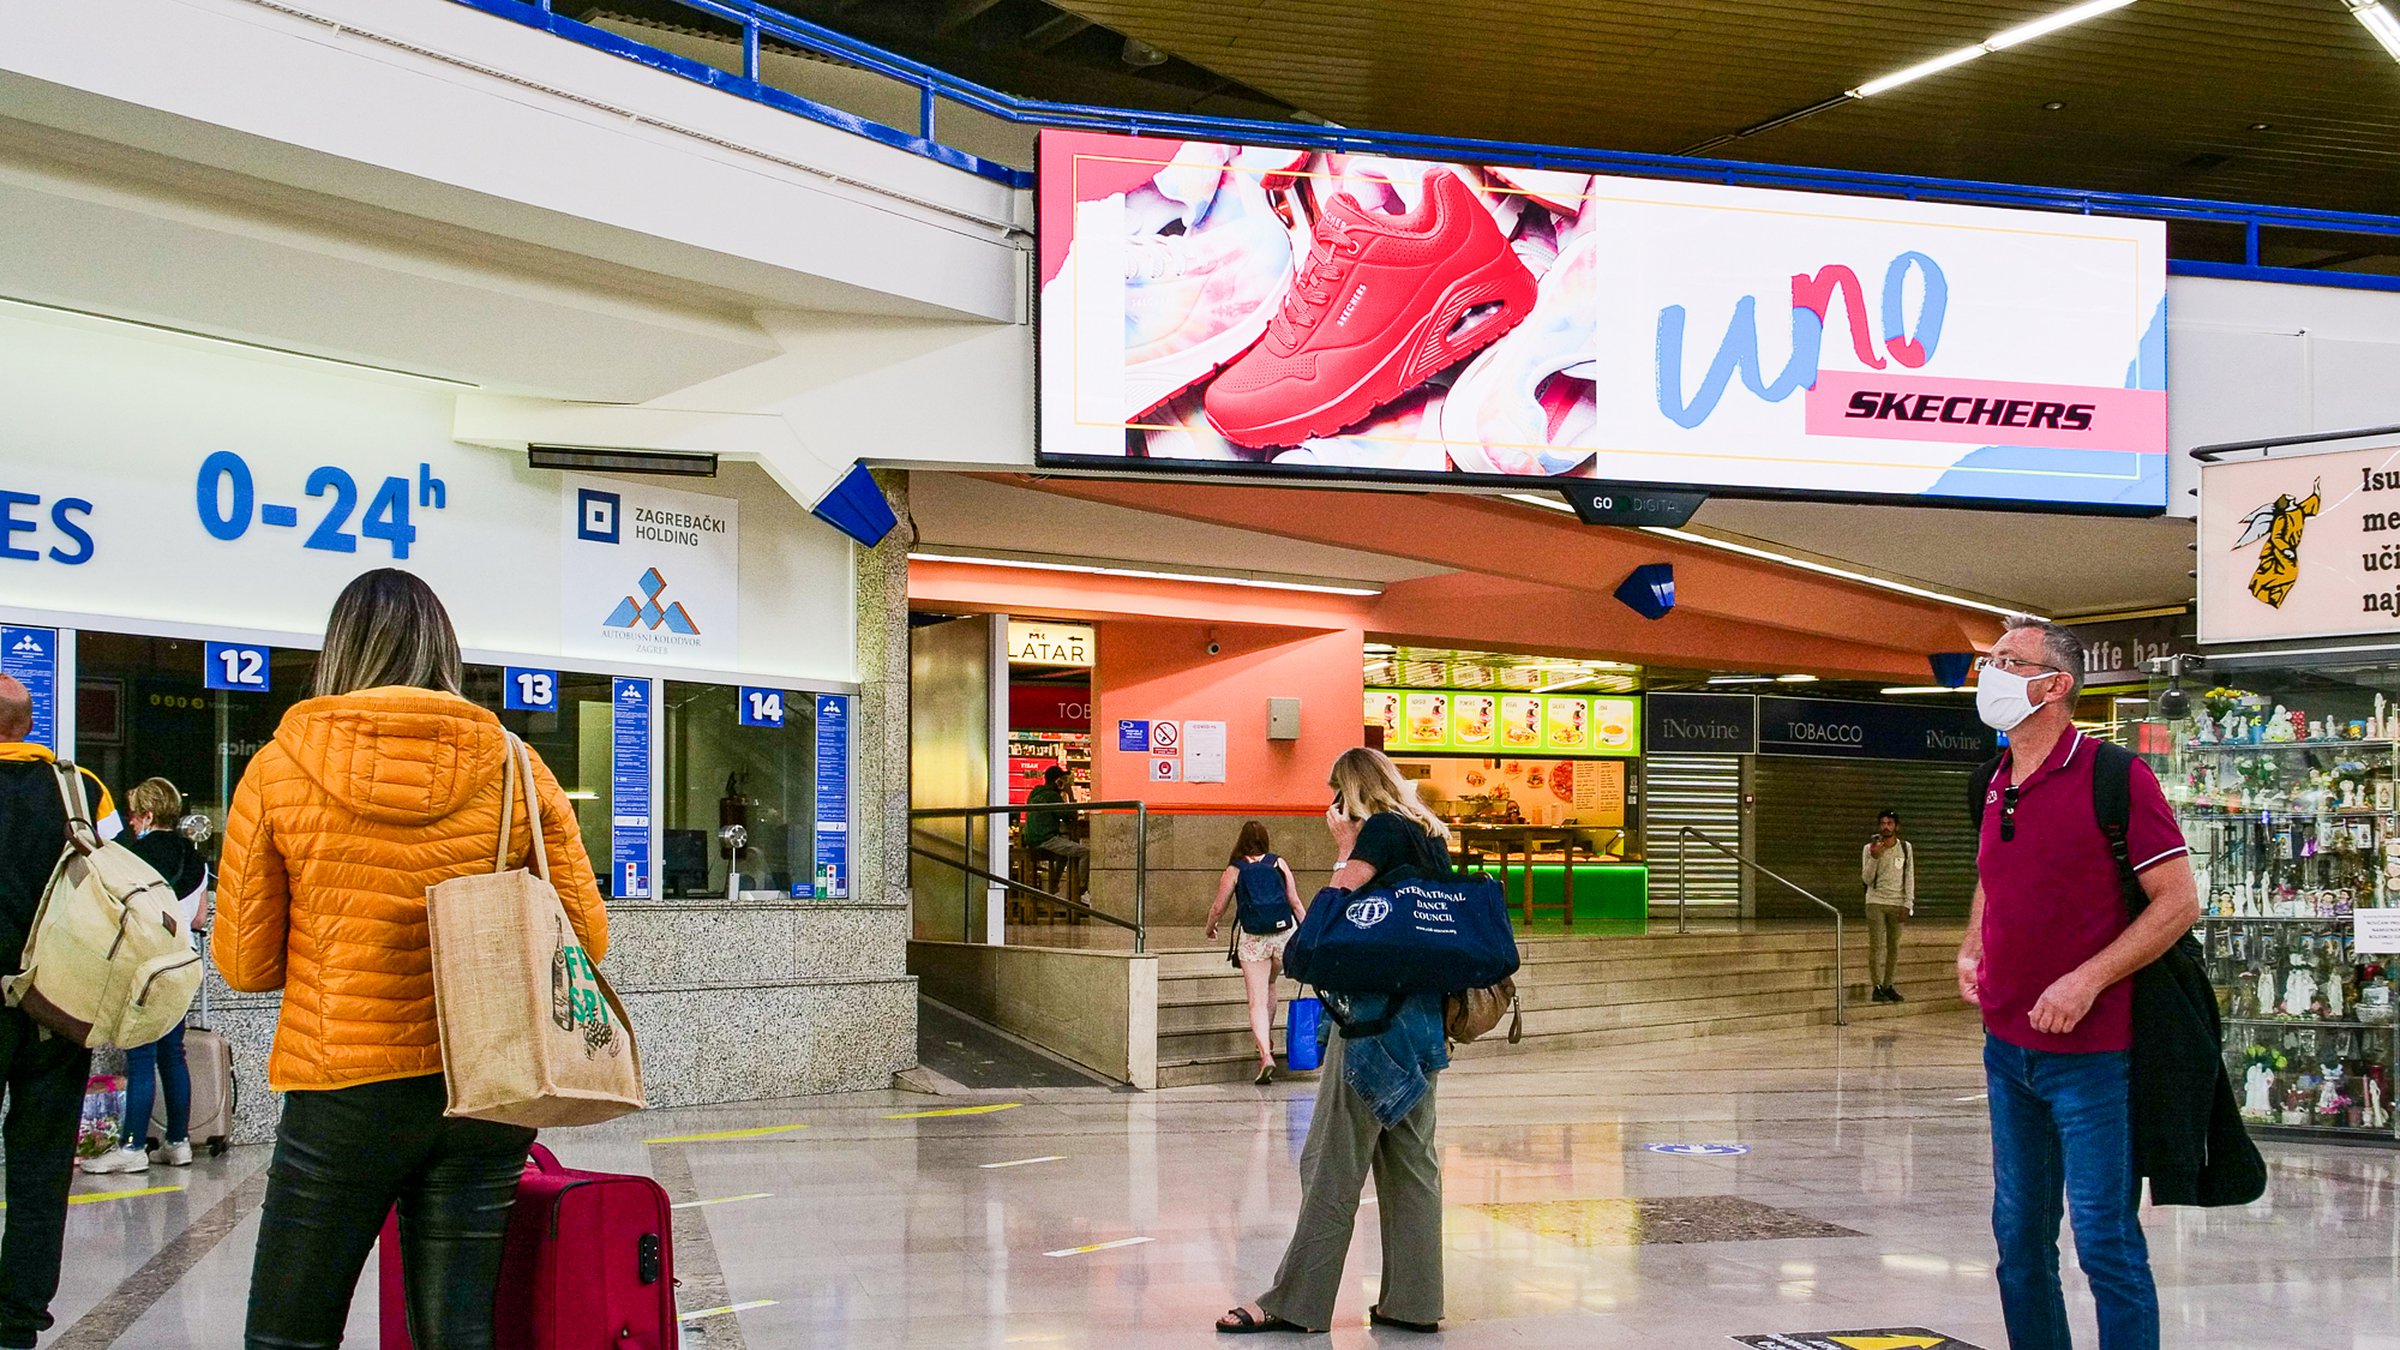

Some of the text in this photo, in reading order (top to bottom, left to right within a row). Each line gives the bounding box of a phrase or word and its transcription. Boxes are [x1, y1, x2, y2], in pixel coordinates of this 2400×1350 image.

[1337, 284, 1367, 326] SKECHERS
[1593, 497, 1682, 513] GO DIGITAL
[0, 489, 94, 565] ES
[635, 508, 726, 533] ZAGREBAČKI
[2362, 511, 2400, 532] me
[635, 526, 699, 546] HOLDING
[601, 630, 702, 647] AUTOBUSNI KOLODVOR
[635, 644, 668, 655] ZAGREB
[2133, 638, 2170, 668] bar
[219, 649, 263, 684] 12
[517, 673, 552, 705] 13
[749, 692, 783, 722] 14
[1663, 718, 1739, 740] iNovine
[1788, 722, 1863, 743] TOBACCO
[1926, 728, 1982, 751] iNovine
[1395, 886, 1467, 902] INTERNATIONAL
[1416, 899, 1448, 911] DANCE
[1413, 910, 1455, 923] COUNCIL
